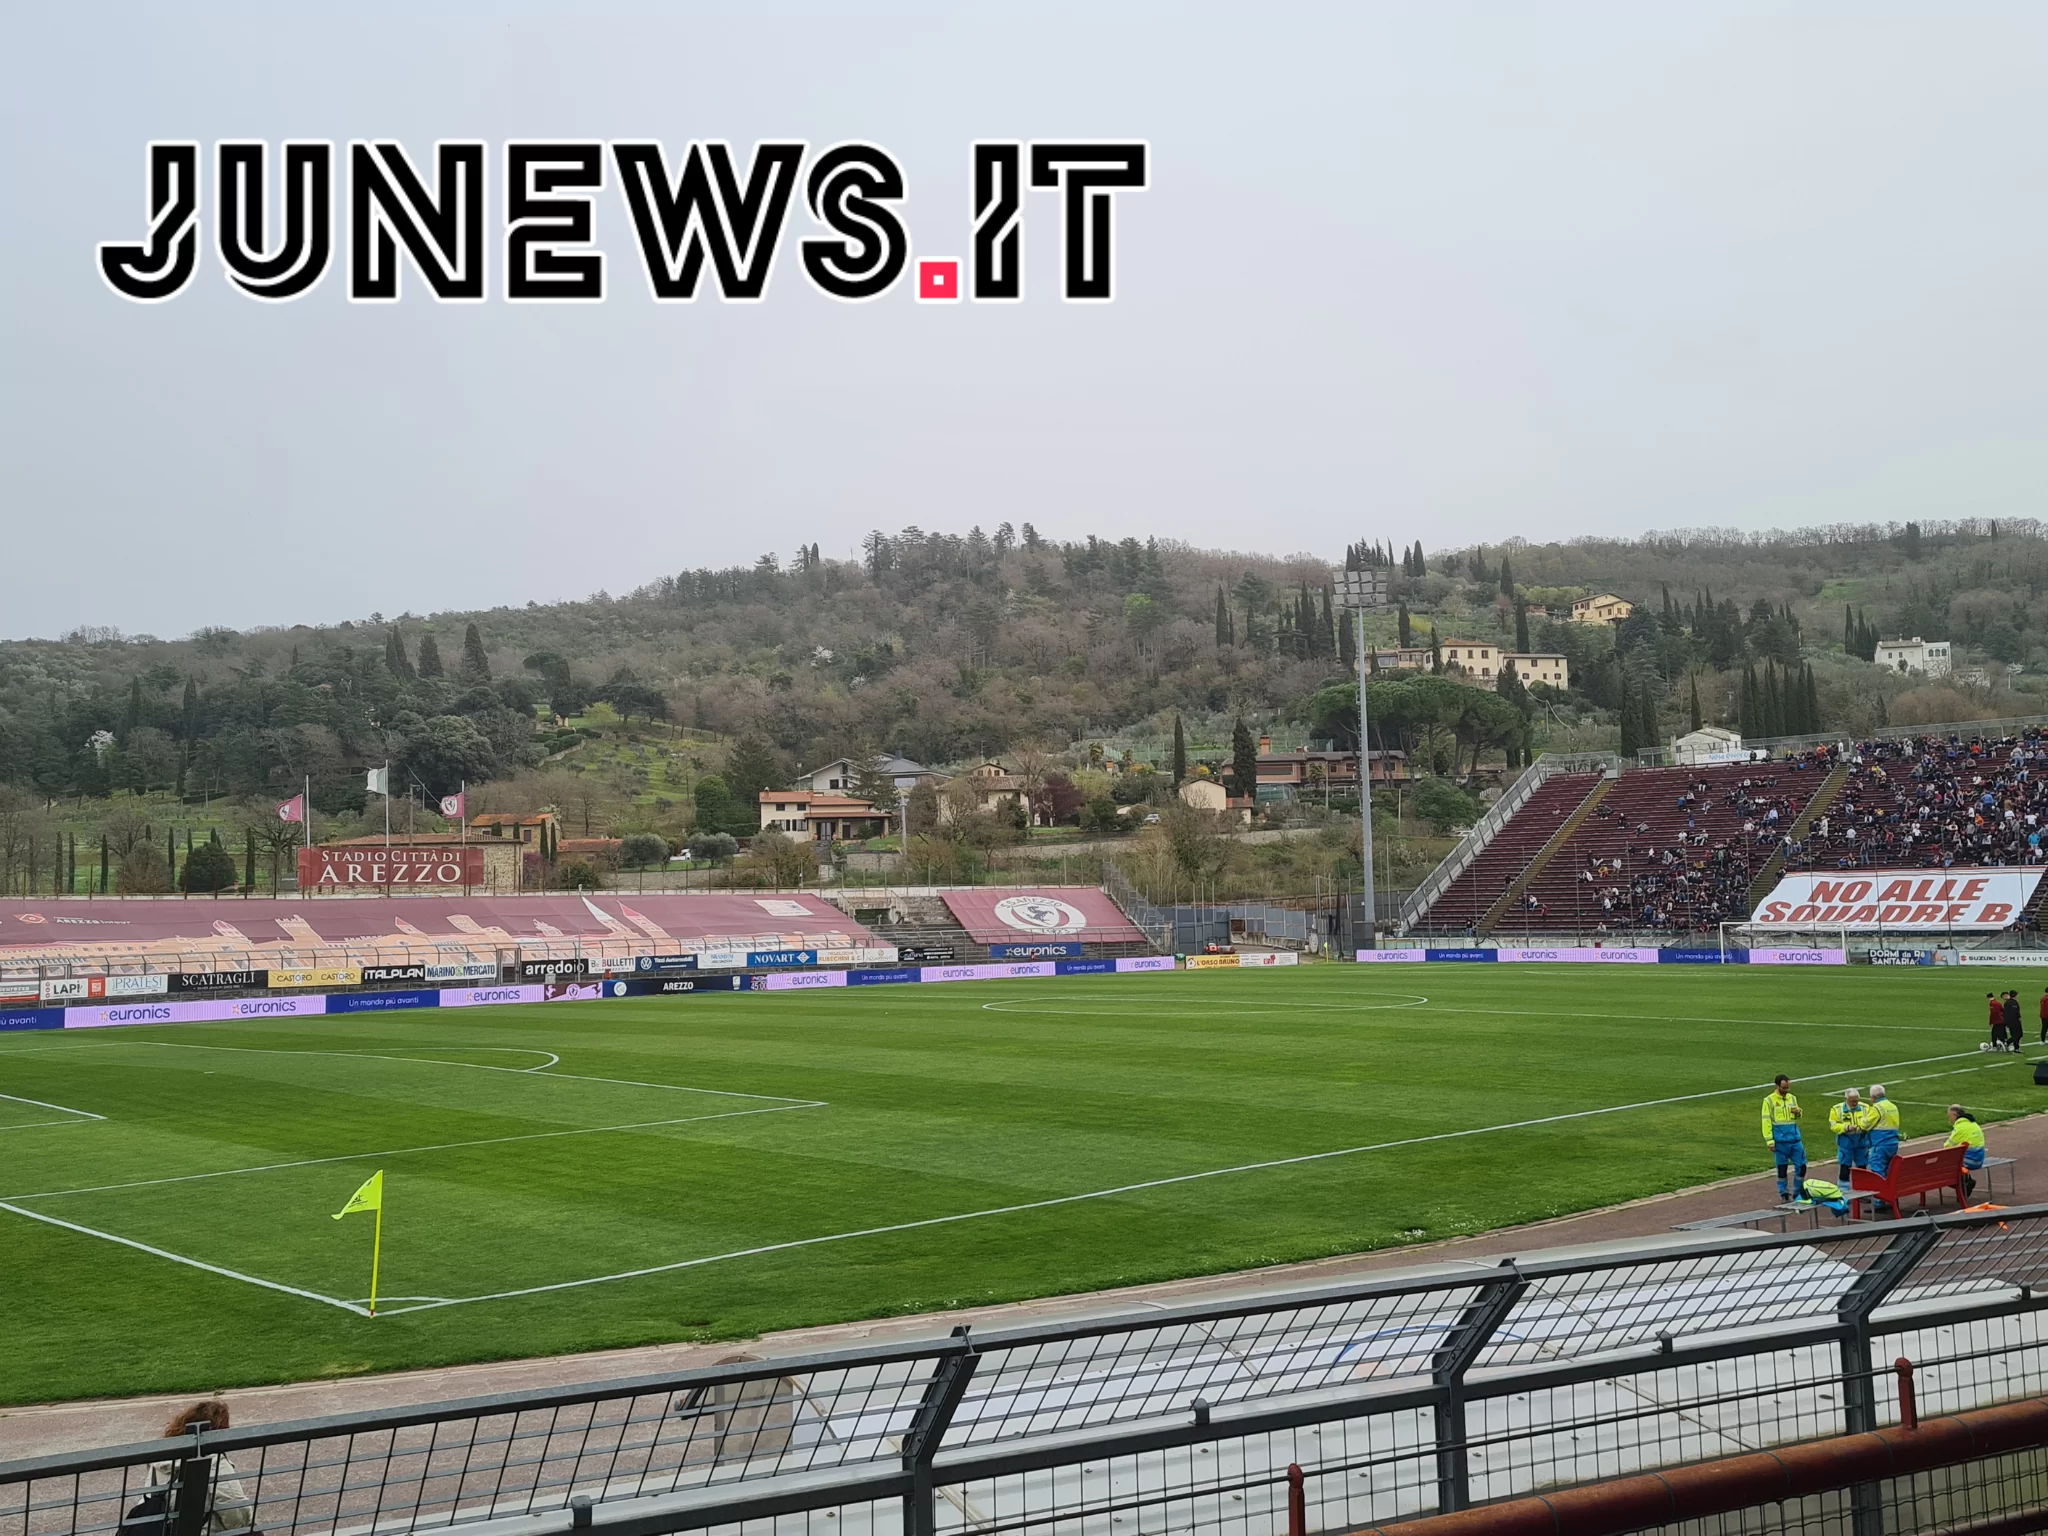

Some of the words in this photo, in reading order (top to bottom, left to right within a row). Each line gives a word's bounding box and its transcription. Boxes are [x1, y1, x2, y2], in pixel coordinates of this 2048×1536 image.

[322, 850, 386, 862] STADIO
[391, 850, 438, 862] CITTÀ
[442, 853, 460, 862] DI
[318, 864, 461, 883] AREZZO
[1807, 880, 1873, 903] NO
[1877, 878, 1990, 902] ALLE
[1976, 903, 2013, 922] B
[1013, 944, 1067, 956] euronics
[1521, 949, 1557, 959] euronics
[1600, 950, 1638, 960] euronics
[754, 954, 794, 964] NOVART
[1377, 951, 1408, 960] euronics
[1778, 951, 1822, 961] euronics
[1010, 964, 1040, 974] euronics
[1134, 960, 1161, 968] euronics
[321, 972, 356, 980] CASTORO
[427, 966, 455, 978] MARINO
[464, 964, 495, 976] MERCATO
[943, 967, 974, 977] euronics
[182, 972, 255, 986] SCATRAGLI
[276, 974, 312, 982] CASTORO
[792, 974, 828, 985] euronics
[663, 982, 694, 990] AREZZO
[474, 988, 520, 1001] euronics
[240, 999, 296, 1014] euronics
[348, 999, 358, 1007] Un
[360, 998, 384, 1006] mondo
[109, 1006, 170, 1020] euronics
[8, 1016, 36, 1025] avanti
